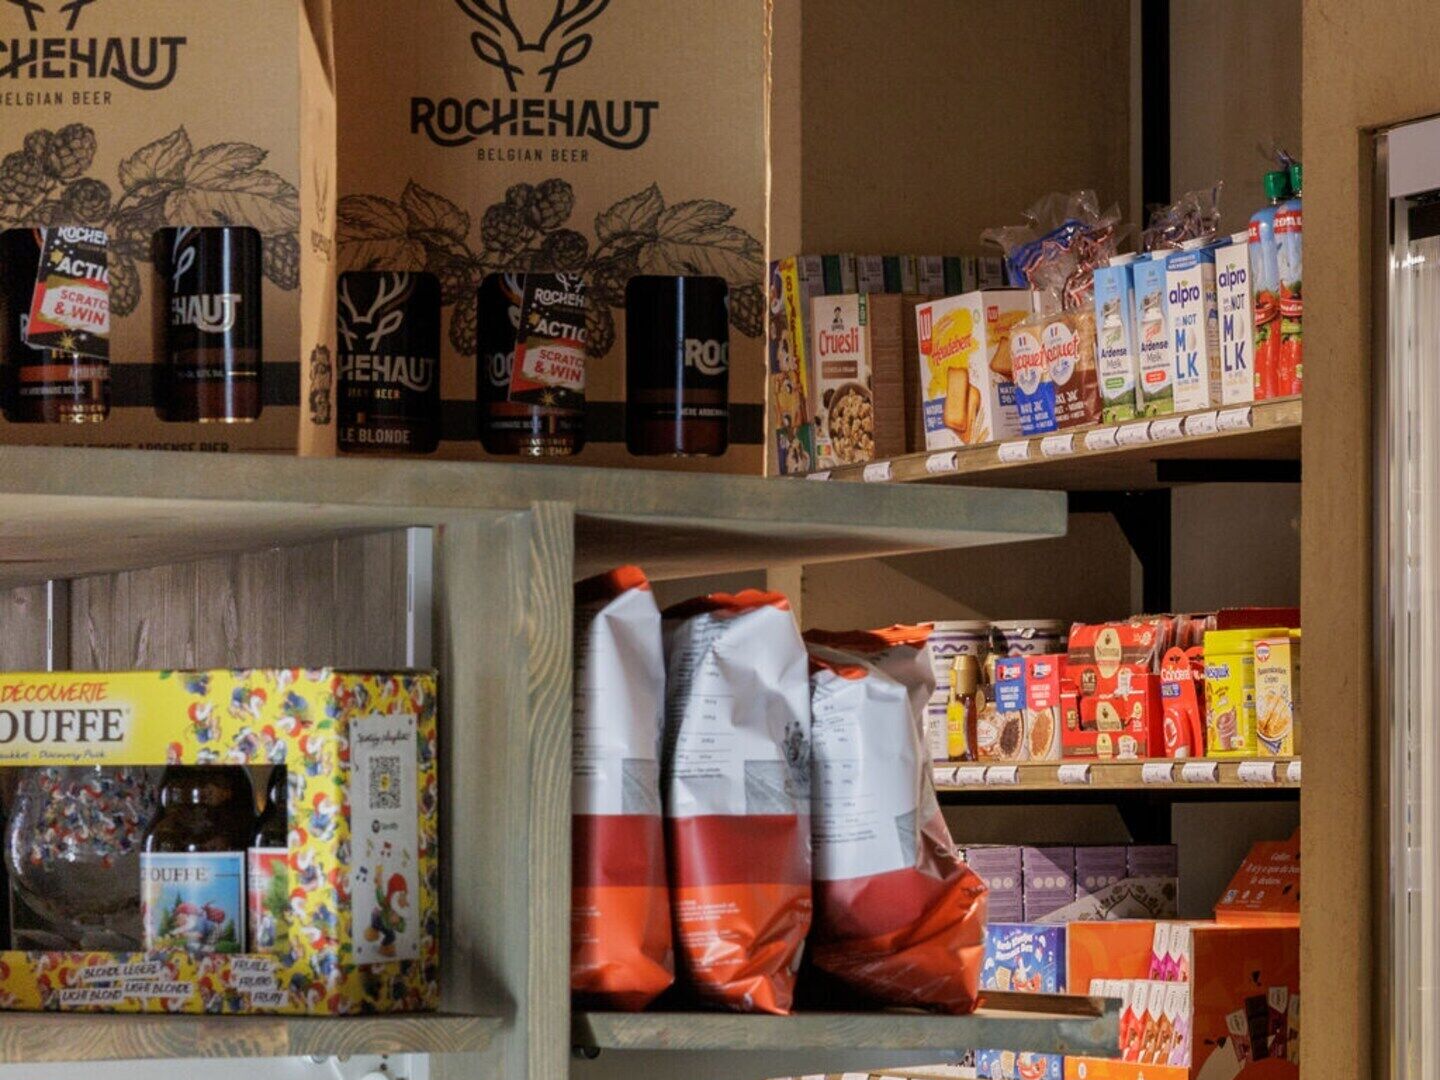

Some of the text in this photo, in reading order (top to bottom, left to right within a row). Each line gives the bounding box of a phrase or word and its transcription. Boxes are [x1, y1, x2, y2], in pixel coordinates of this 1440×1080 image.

[72, 91, 112, 105] BEER
[410, 96, 659, 150] ROCHEHAUT
[477, 149, 589, 162] BELGIAN BEER
[1218, 267, 1247, 292] alpro
[1169, 284, 1200, 309] alpro
[71, 304, 106, 327] WIN
[819, 327, 859, 356] Cruesli
[1101, 346, 1127, 358] Ardense
[1141, 340, 1168, 352] Ardense
[547, 364, 582, 383] WIN
[358, 427, 411, 445] BLONDE
[2, 680, 110, 703] DÉCOUVERTE
